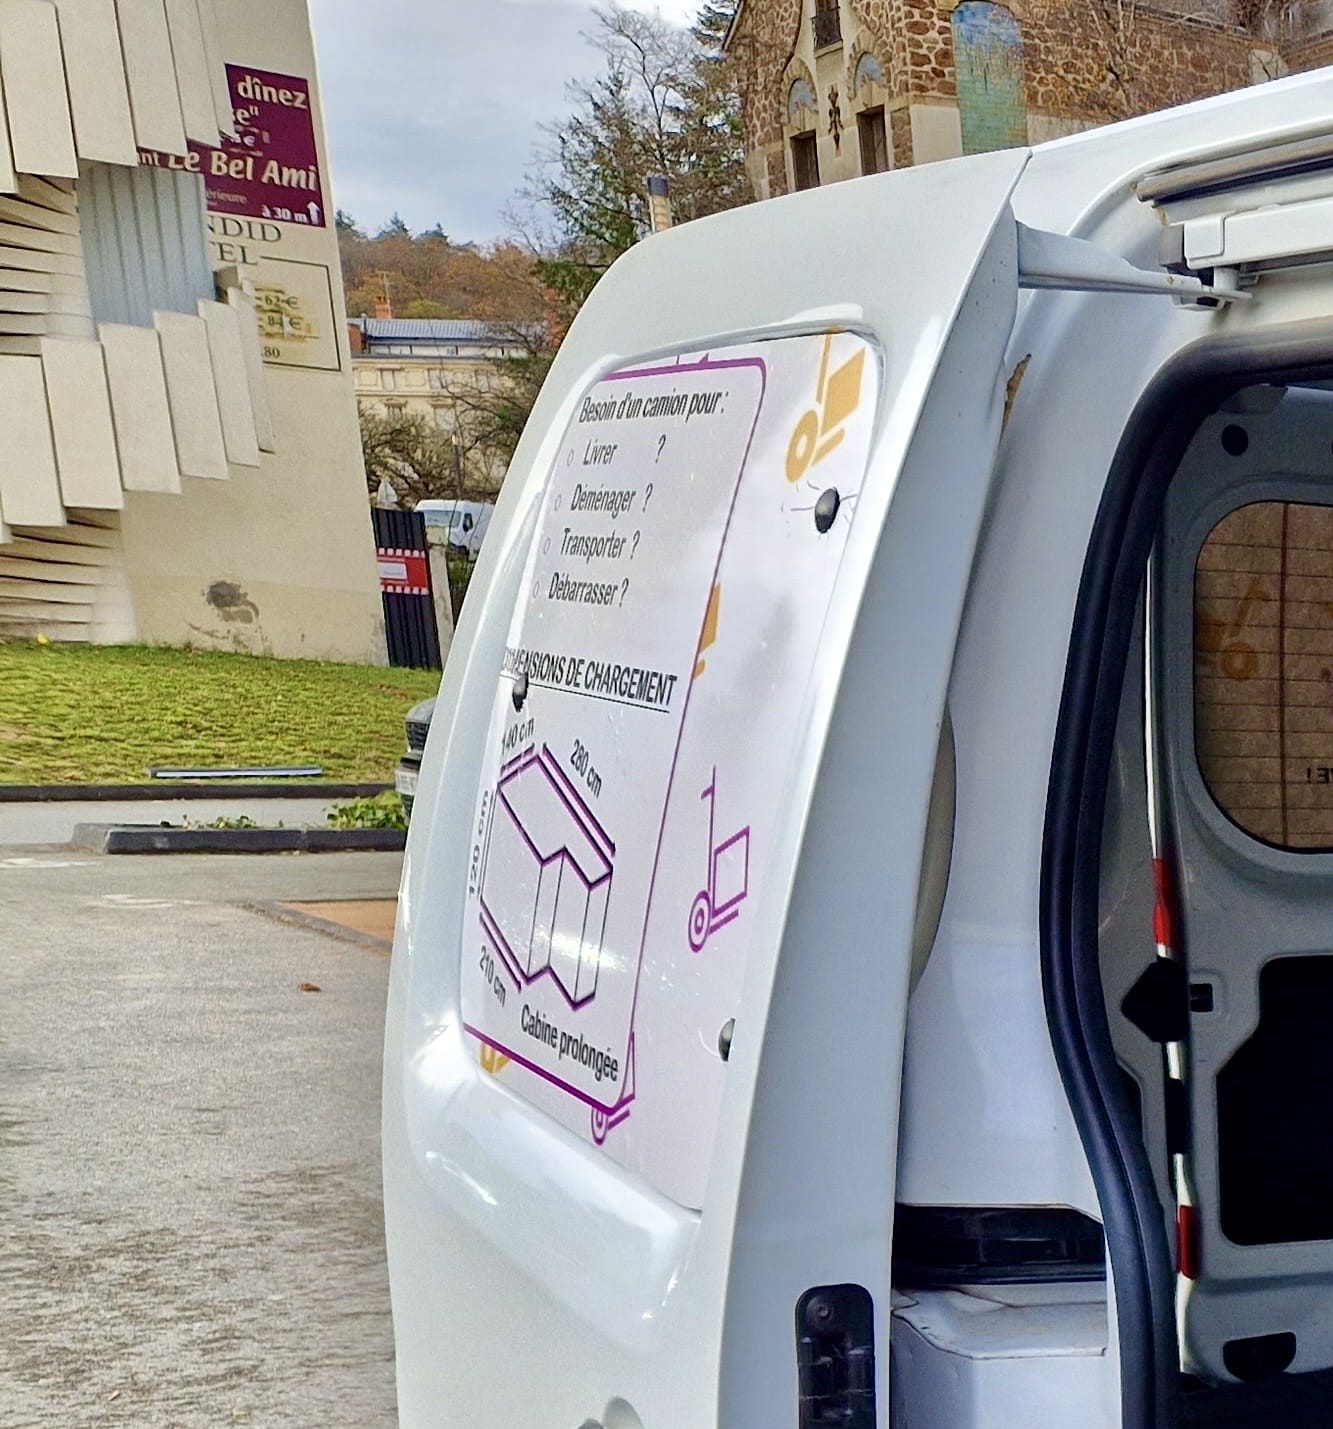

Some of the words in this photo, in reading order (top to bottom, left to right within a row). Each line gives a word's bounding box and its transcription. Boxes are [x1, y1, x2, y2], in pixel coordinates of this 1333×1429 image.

[237, 74, 308, 109] dînez
[210, 150, 254, 181] Bel
[261, 160, 317, 191] Ami
[274, 207, 292, 221] 30
[579, 395, 616, 423] Besoin
[616, 392, 642, 419] d'un
[643, 387, 688, 417] camion
[685, 391, 722, 423] pour
[583, 438, 618, 466] Livrer
[570, 482, 636, 519] Déménager
[560, 527, 627, 565] Transporter
[548, 571, 618, 606] Débarrasser
[565, 657, 585, 688] DE
[584, 660, 678, 707] CHARGEMENT
[570, 738, 590, 778] 280
[586, 765, 603, 799] cm
[479, 945, 495, 985] 210
[493, 975, 506, 1008] cm
[520, 1003, 558, 1049] Cabine
[558, 1030, 619, 1082] prolongée
